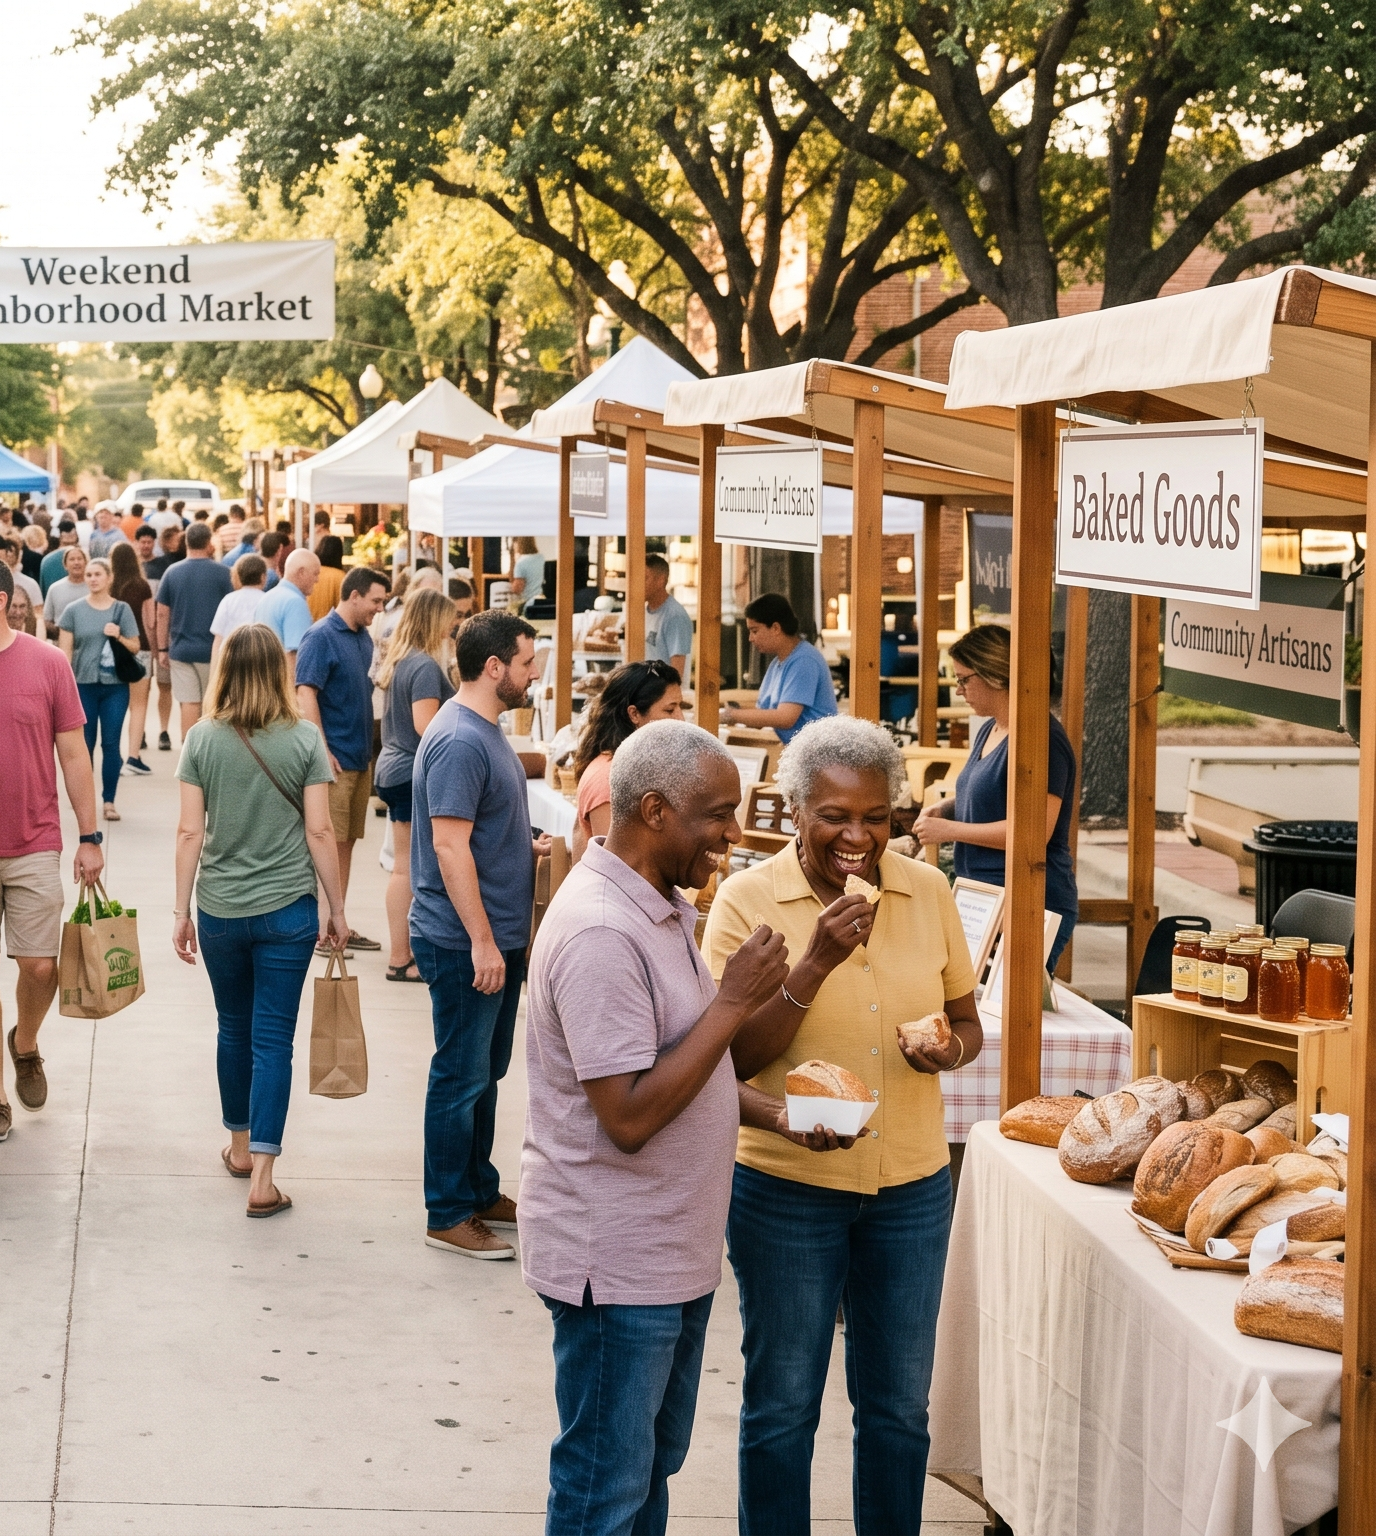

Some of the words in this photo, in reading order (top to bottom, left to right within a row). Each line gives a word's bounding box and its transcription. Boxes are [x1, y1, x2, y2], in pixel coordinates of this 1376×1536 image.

[21, 255, 191, 286] Weekend
[179, 291, 313, 323] Market
[719, 475, 770, 526] Community
[771, 475, 815, 517] Artisans
[1071, 471, 1145, 544] Baked
[1153, 470, 1240, 551] Goods
[1171, 610, 1256, 670] Community
[1257, 623, 1332, 673] Artisans
